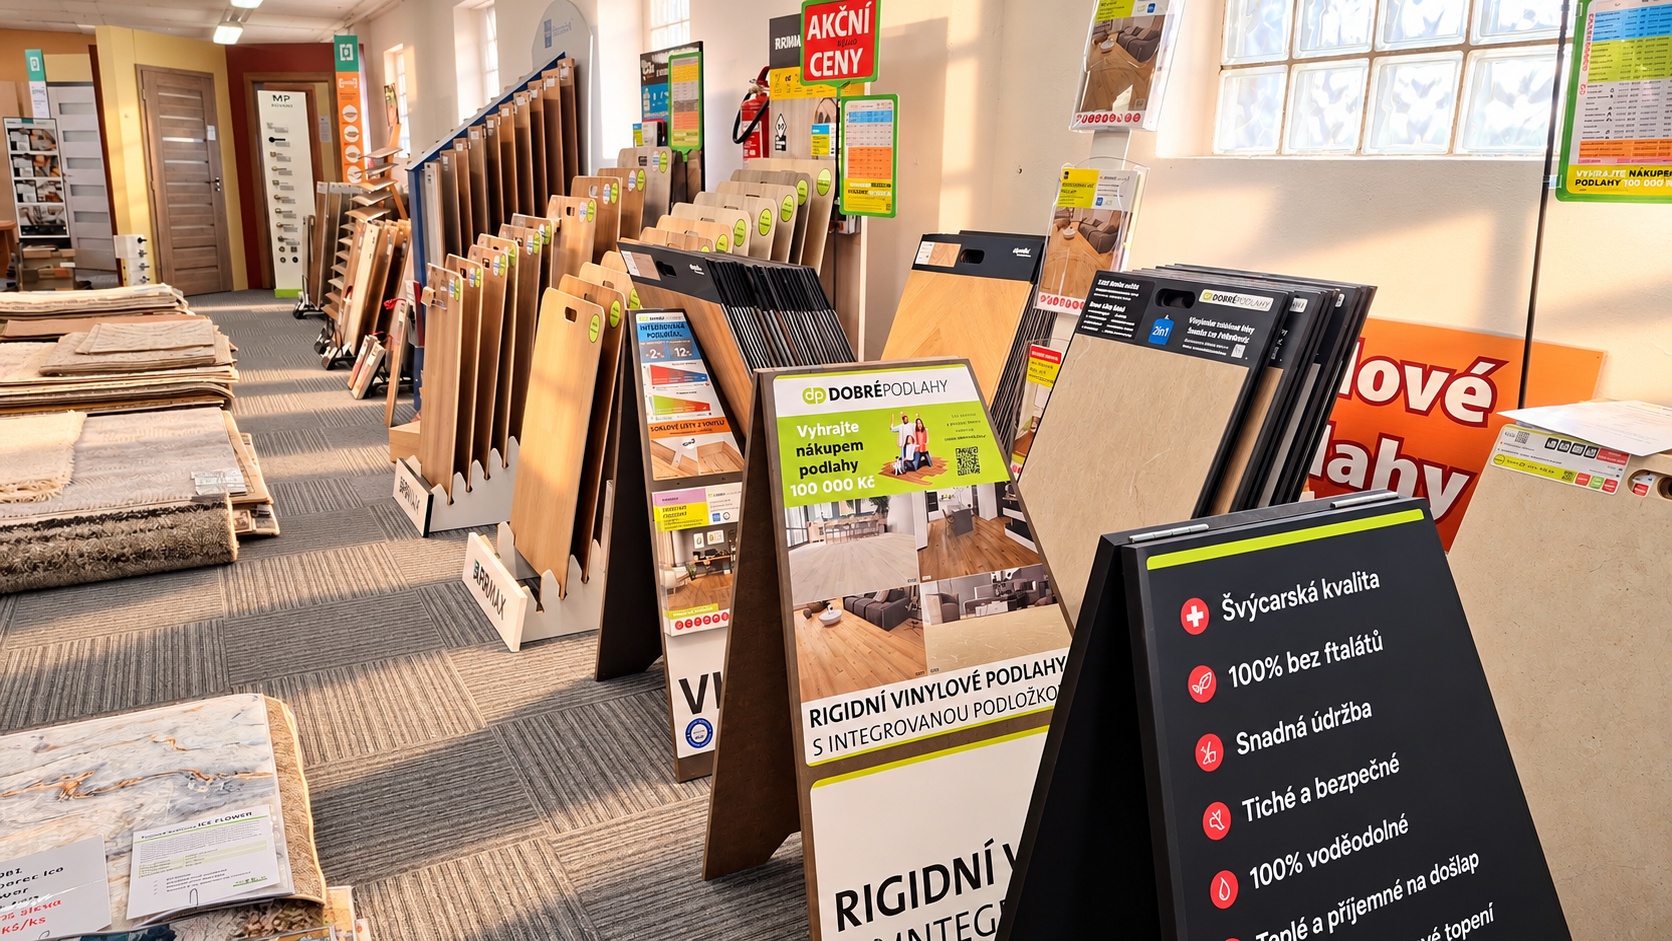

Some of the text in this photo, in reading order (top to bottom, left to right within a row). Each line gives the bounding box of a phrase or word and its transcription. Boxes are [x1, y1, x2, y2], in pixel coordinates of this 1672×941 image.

[807, 1, 872, 41] AKČNÍ
[810, 48, 864, 78] CENY
[1575, 179, 1621, 187] PODLAHY
[1629, 167, 1672, 177] NÁKUPE
[1152, 326, 1169, 337] 2in1
[829, 379, 948, 402] DOBRÉPODLAHY
[796, 440, 864, 457] nákupem
[797, 420, 860, 438] Vyhrajte
[790, 474, 875, 497] 100 000 Kč
[799, 459, 859, 479] podlahy
[1221, 571, 1380, 622] Švýcarská kvalita
[1228, 629, 1384, 688] 100% bez ftalátů
[809, 655, 1067, 728] RIGIDNÍ VINYLOVÉ PODLAHY
[813, 684, 1060, 756] S INTEGROVANOU PODLOŽKO
[1236, 701, 1372, 755] Snadná údržba
[1241, 752, 1400, 822] Tiché a bezpečné
[1250, 812, 1409, 889] 100% voděodolné
[835, 838, 995, 932] RIGIDNÍ
[1312, 917, 1323, 934] a
[1327, 879, 1404, 935] příjemné
[1406, 875, 1427, 895] na
[1429, 852, 1480, 885] došlap
[1444, 902, 1494, 941] topení
